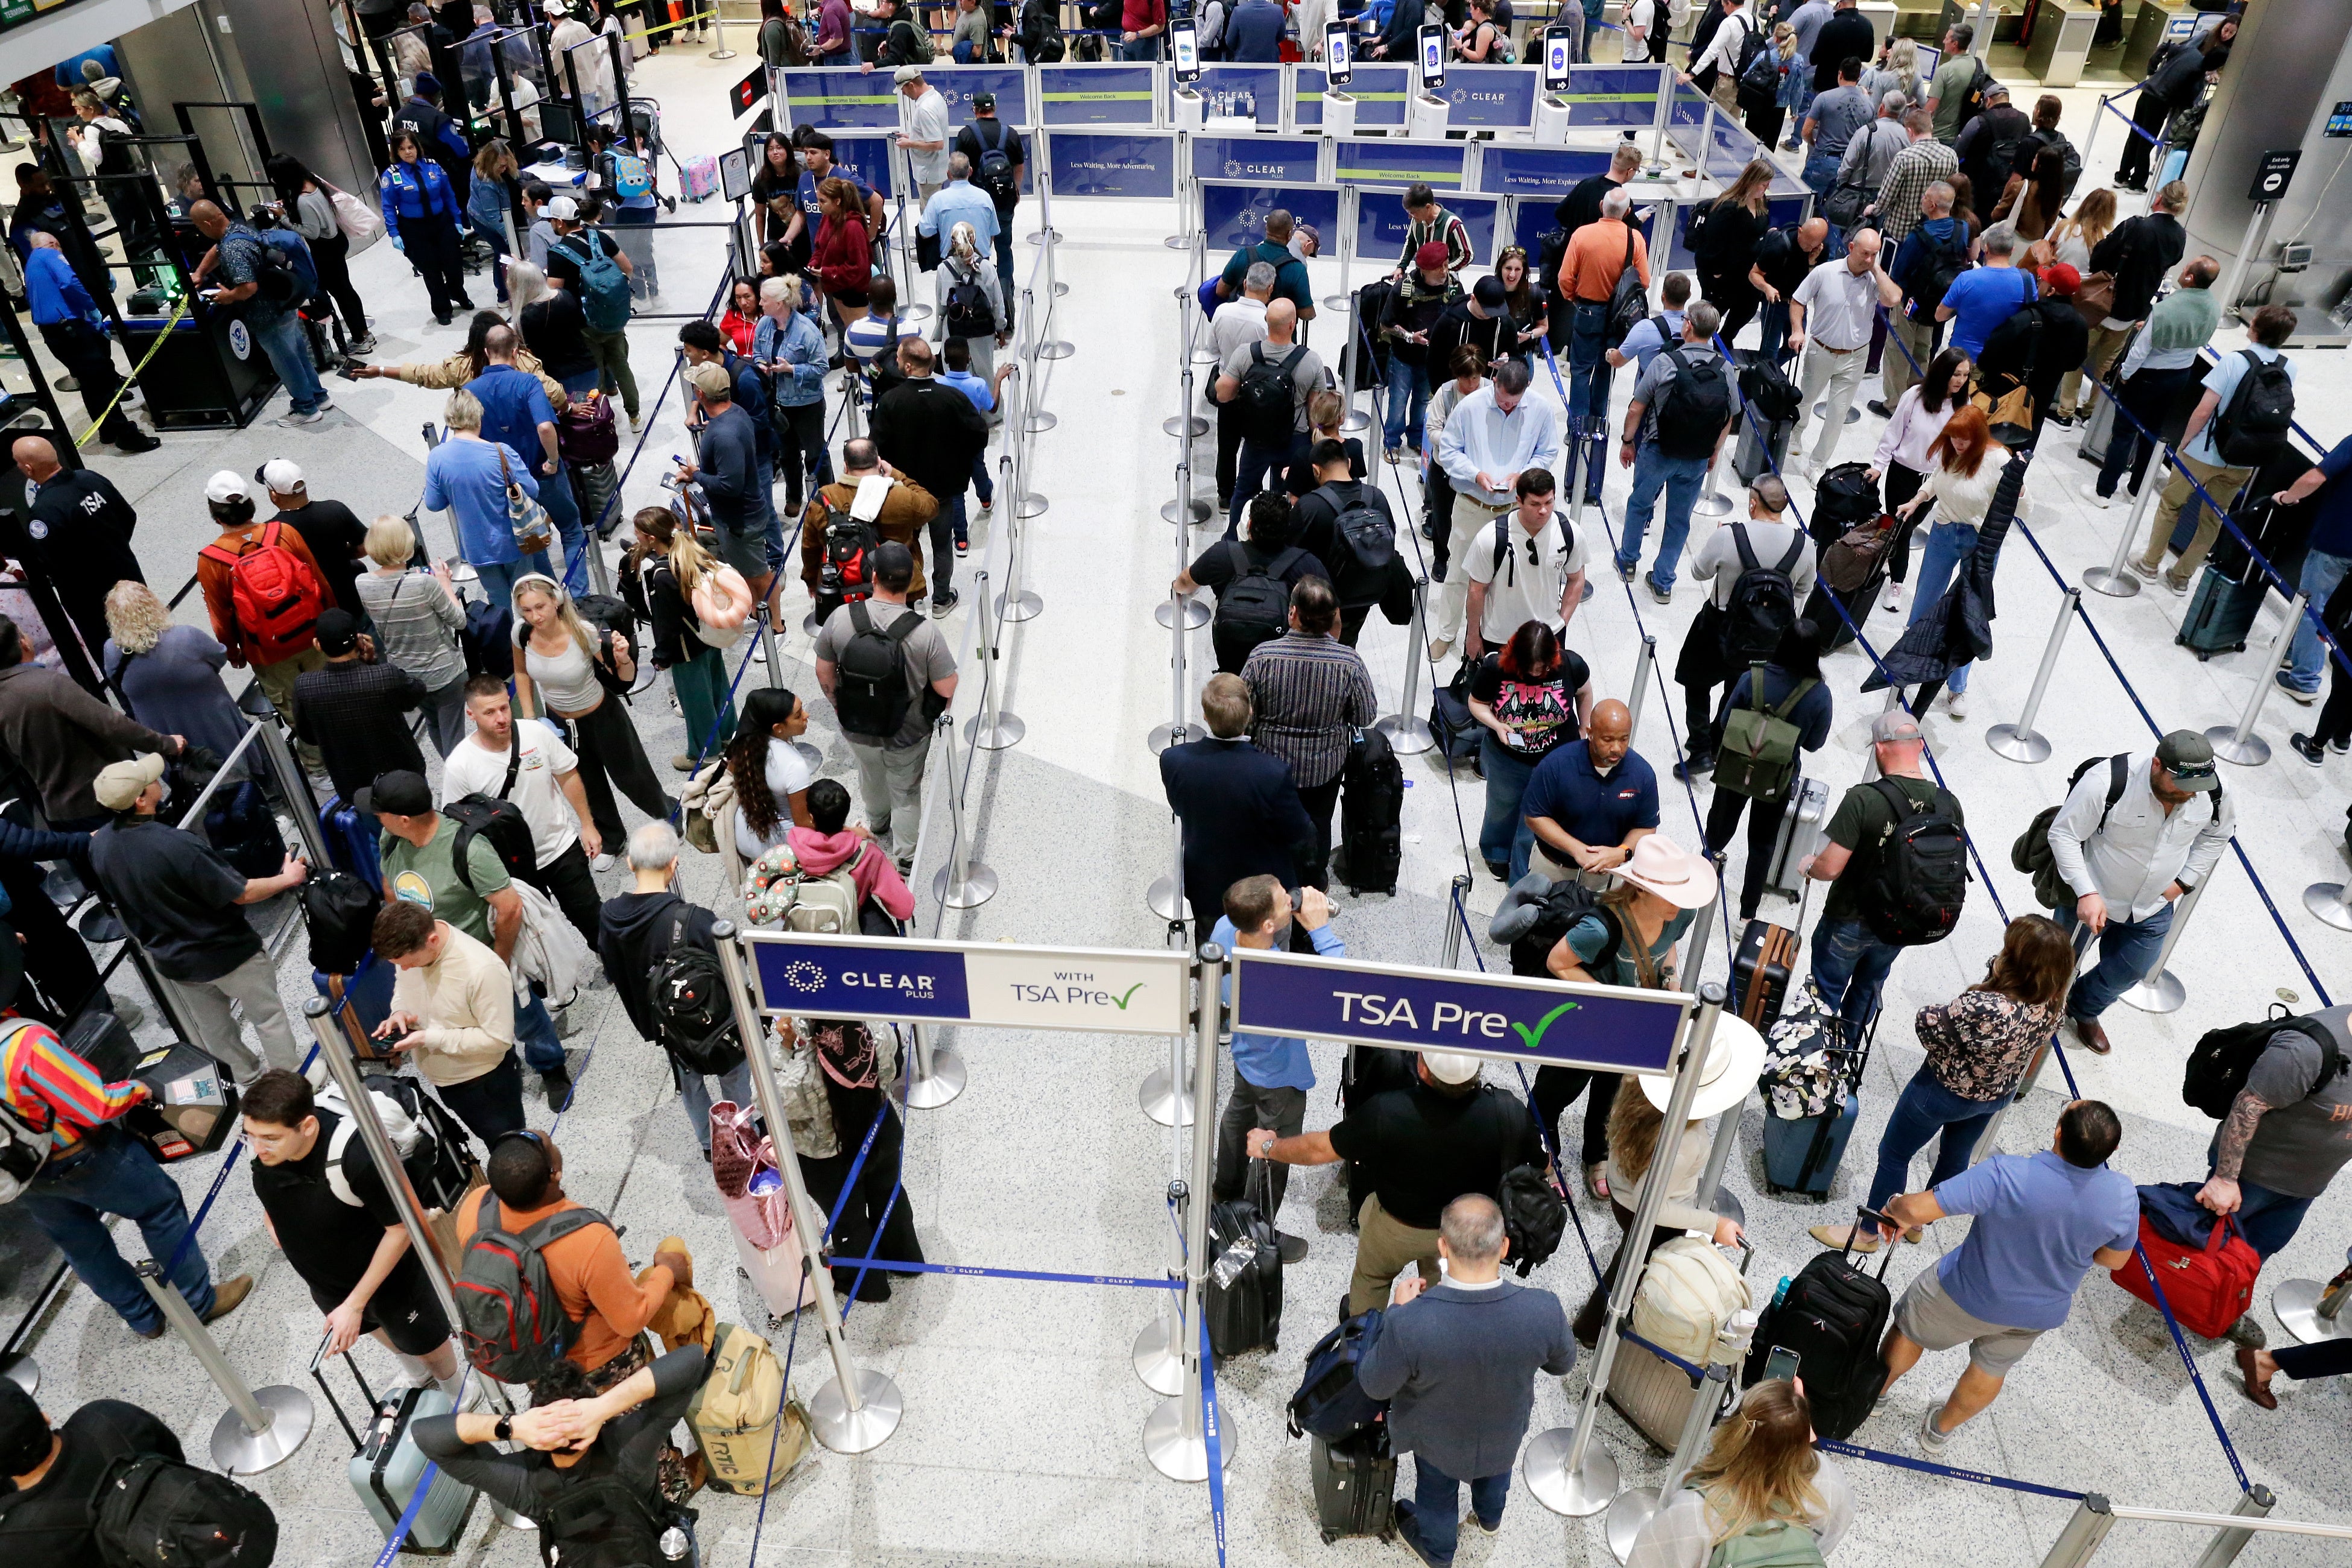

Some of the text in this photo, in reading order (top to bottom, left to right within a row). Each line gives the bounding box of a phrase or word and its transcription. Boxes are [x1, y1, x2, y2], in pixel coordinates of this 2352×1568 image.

[4, 4, 31, 19] TERMINAL
[1472, 93, 1505, 101] CLEAR
[402, 120, 419, 133] TSA
[1247, 165, 1284, 174] CLEAR
[174, 301, 188, 319] ENTER
[80, 492, 107, 516] TSA
[841, 972, 933, 990] CLEAR
[1055, 972, 1095, 982] WITH
[905, 991, 934, 999] PLUS
[1011, 985, 1111, 1005] TSA Pre
[1333, 991, 1508, 1038] TSA Pre
[868, 1123, 879, 1143] CLEAR
[2140, 1251, 2151, 1274] UNITED
[2180, 1343, 2192, 1369] UNITED
[1827, 1443, 1856, 1453] UNITED
[710, 1441, 739, 1476] RTIC
[2226, 1445, 2240, 1474] UNITED
[1950, 1470, 1981, 1481] UNITED
[381, 1535, 400, 1565] UNITED
